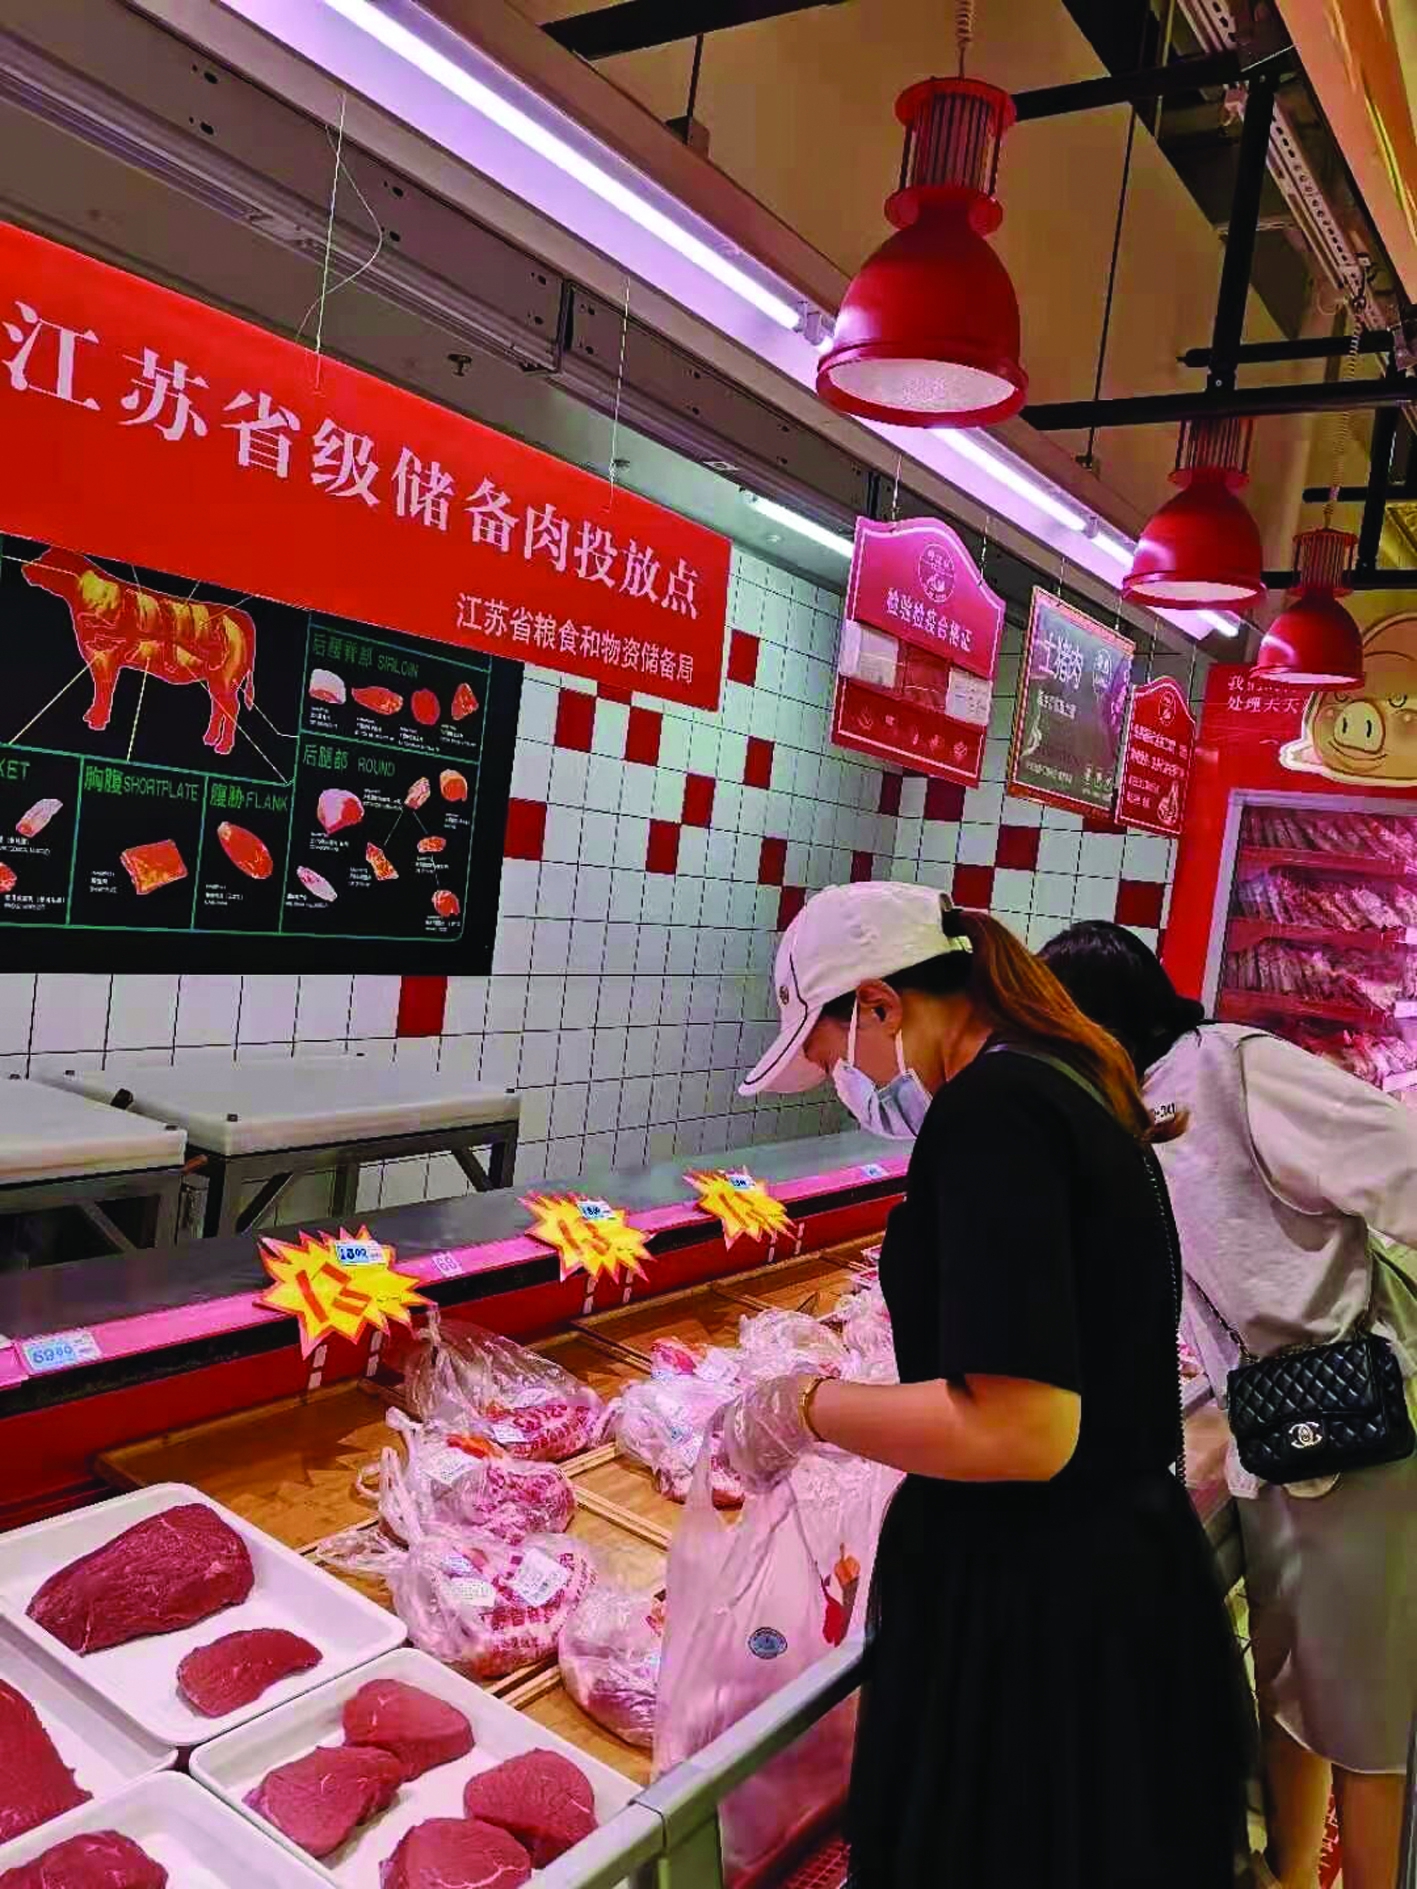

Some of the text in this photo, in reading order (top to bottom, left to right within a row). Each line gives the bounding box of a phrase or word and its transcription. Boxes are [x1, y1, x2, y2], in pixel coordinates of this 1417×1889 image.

[2, 301, 701, 619] 江苏省级储备肉投放点
[456, 592, 694, 684] 江苏省粮食和物资储备局
[302, 744, 396, 777] 后腿部 ROUND
[245, 791, 289, 812] FLANK
